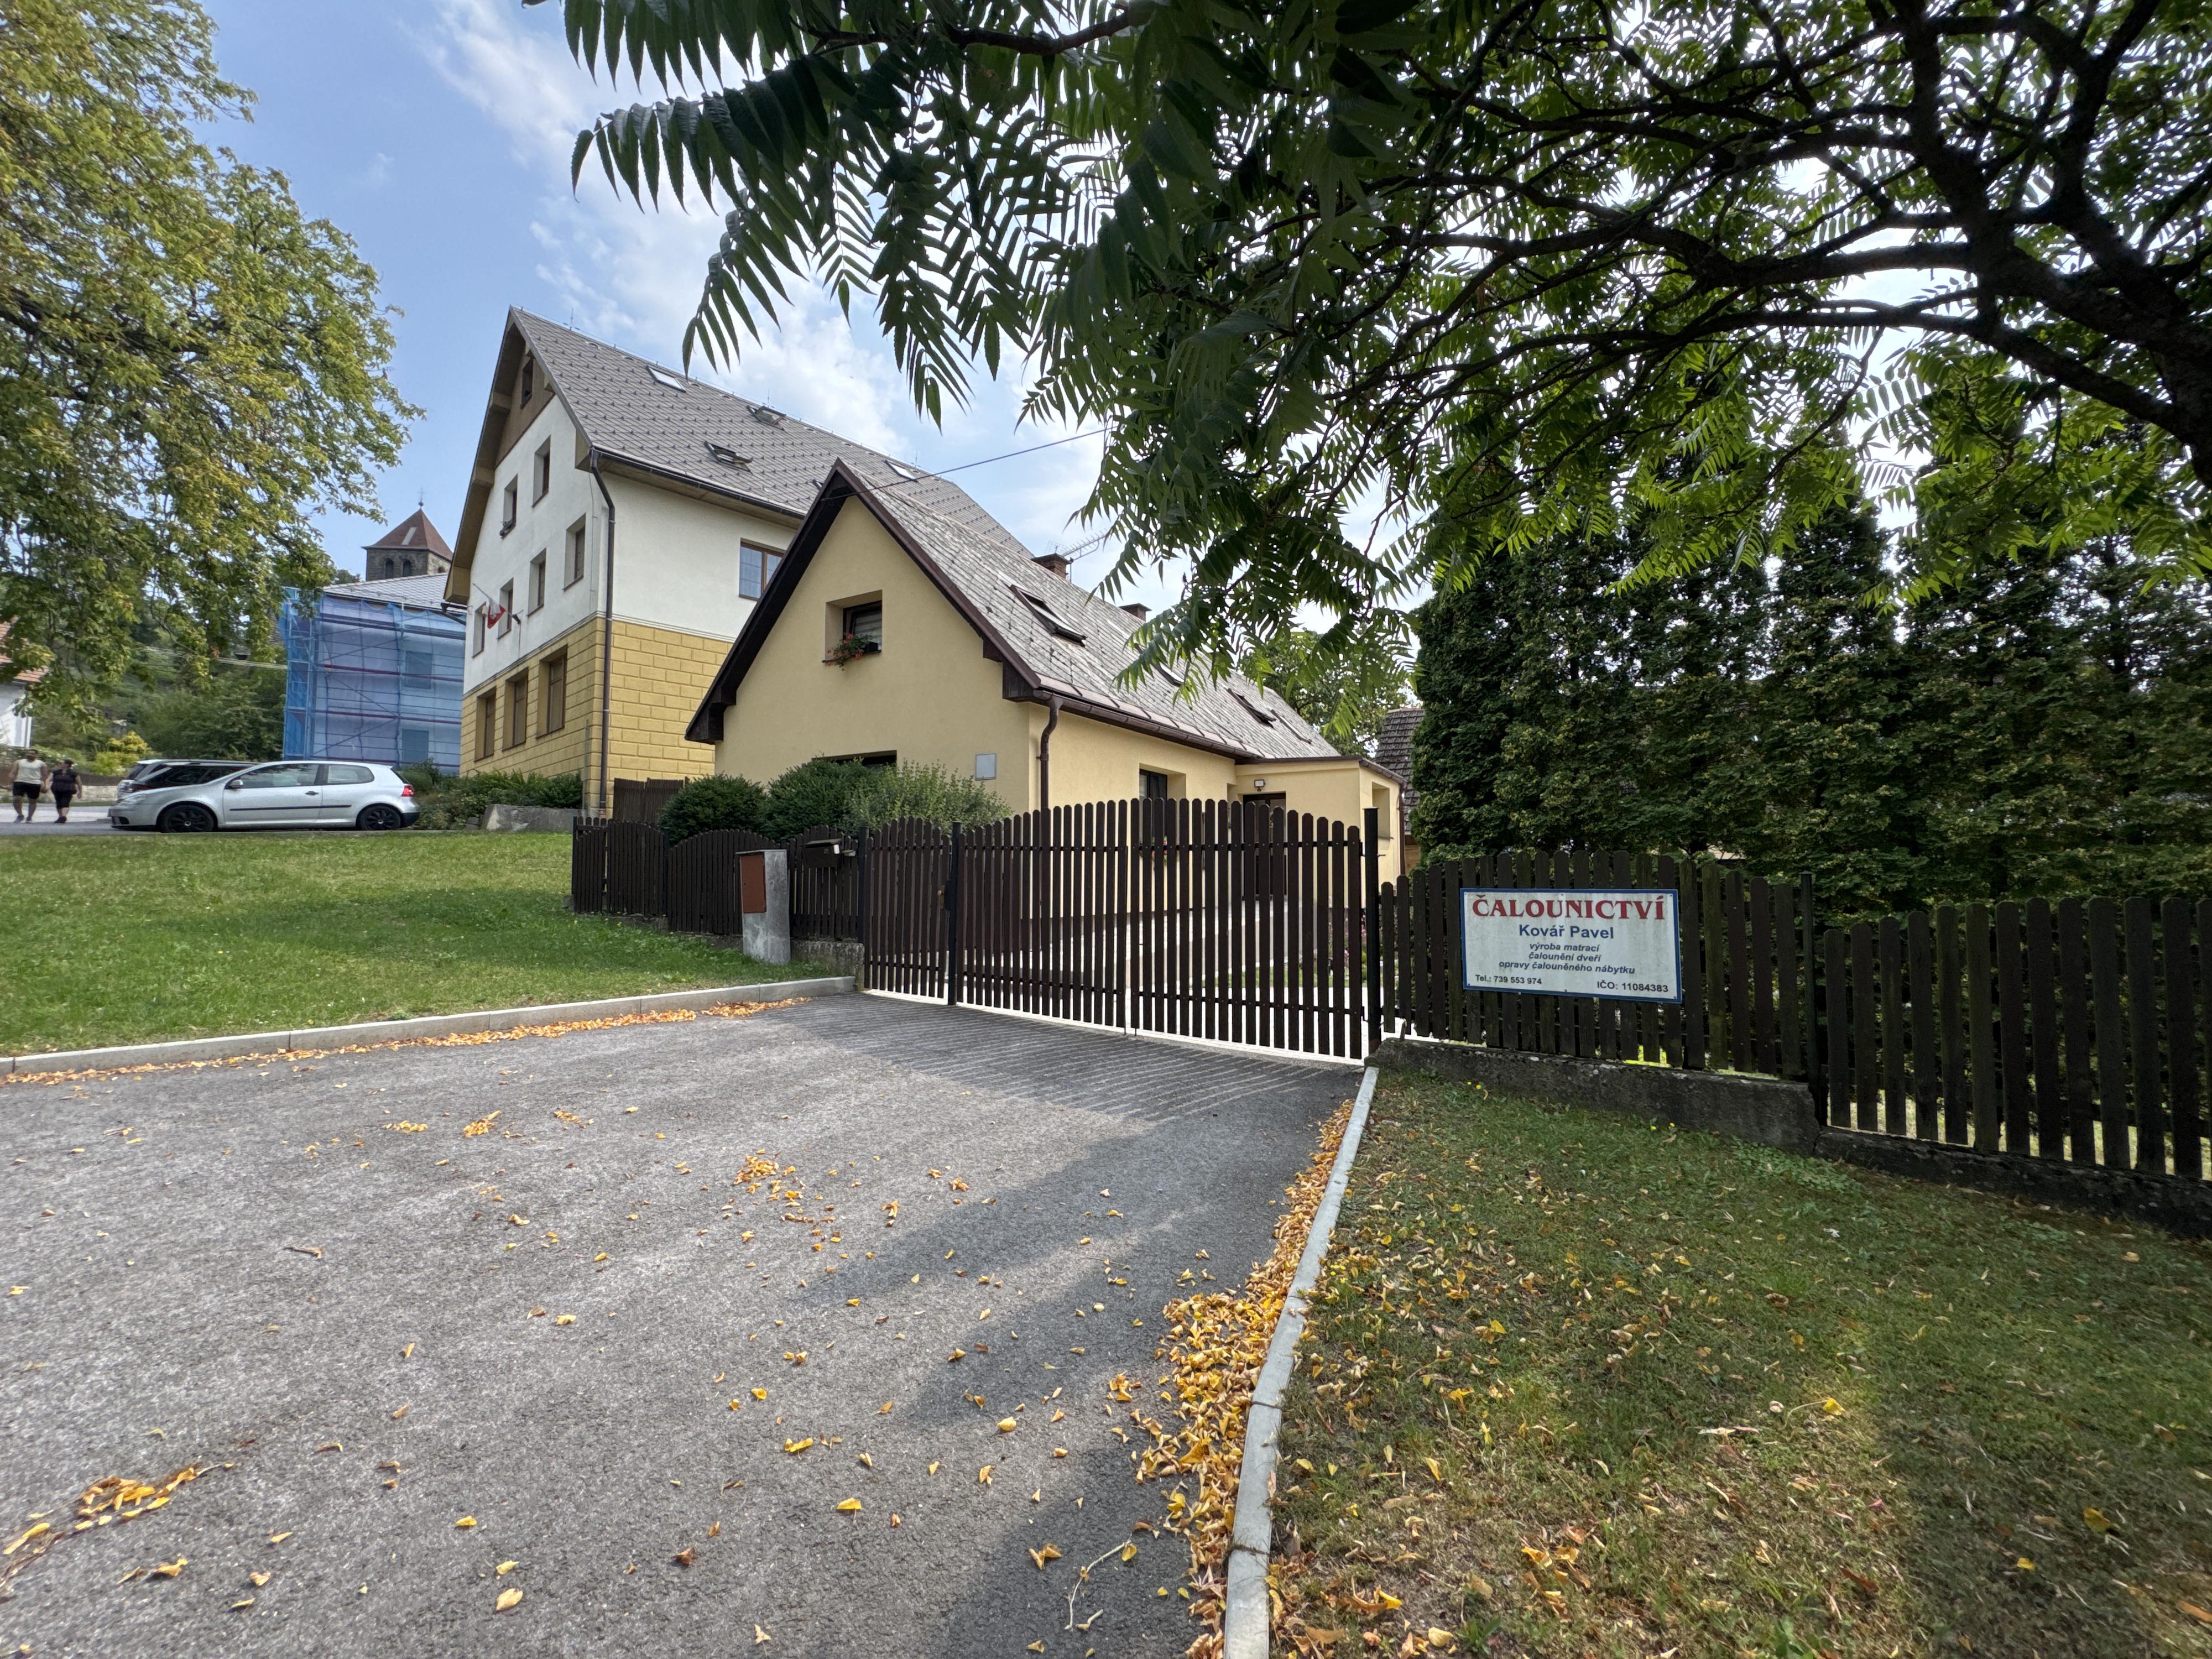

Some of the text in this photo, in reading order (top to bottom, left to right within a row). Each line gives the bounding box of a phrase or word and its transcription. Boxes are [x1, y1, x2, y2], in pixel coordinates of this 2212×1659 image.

[1472, 894, 1665, 920] ČALOUNICTVÍ
[1519, 924, 1614, 939] Kovář Pavel
[1530, 942, 1561, 951] výroba
[1528, 952, 1574, 961] čalounění
[1499, 961, 1635, 975] opravy čalouněného nábytku
[1597, 980, 1668, 993] IČO: 11084383
